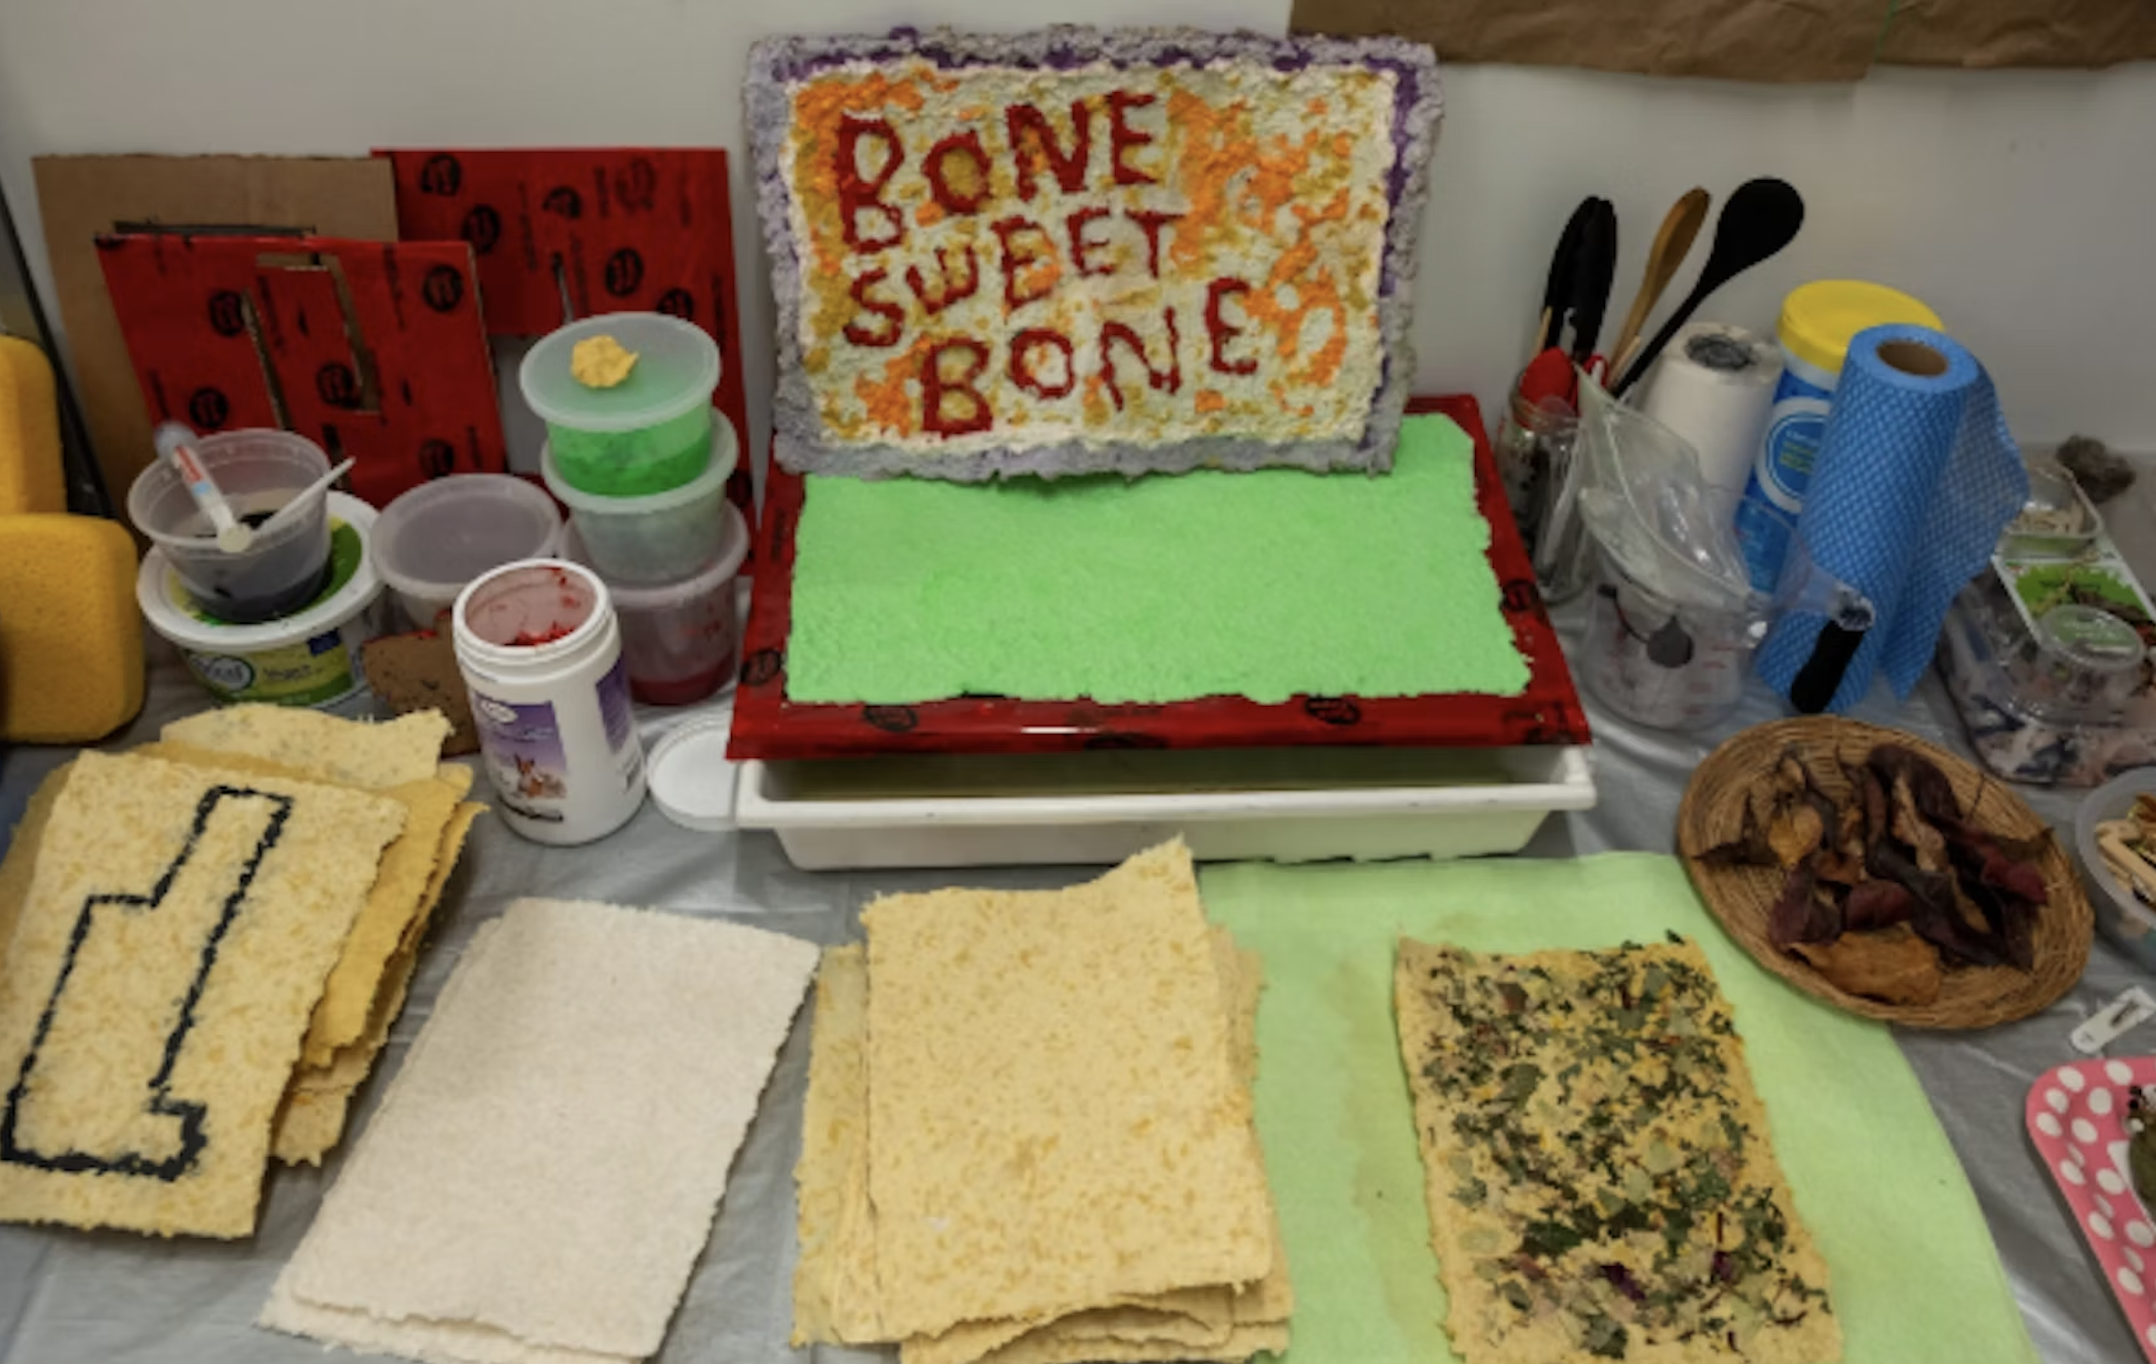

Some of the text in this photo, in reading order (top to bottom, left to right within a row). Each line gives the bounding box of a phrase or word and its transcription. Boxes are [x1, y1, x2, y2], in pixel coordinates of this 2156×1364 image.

[836, 90, 1158, 254] BONE
[842, 206, 1184, 347] SWEET
[919, 275, 1258, 437] BONE
